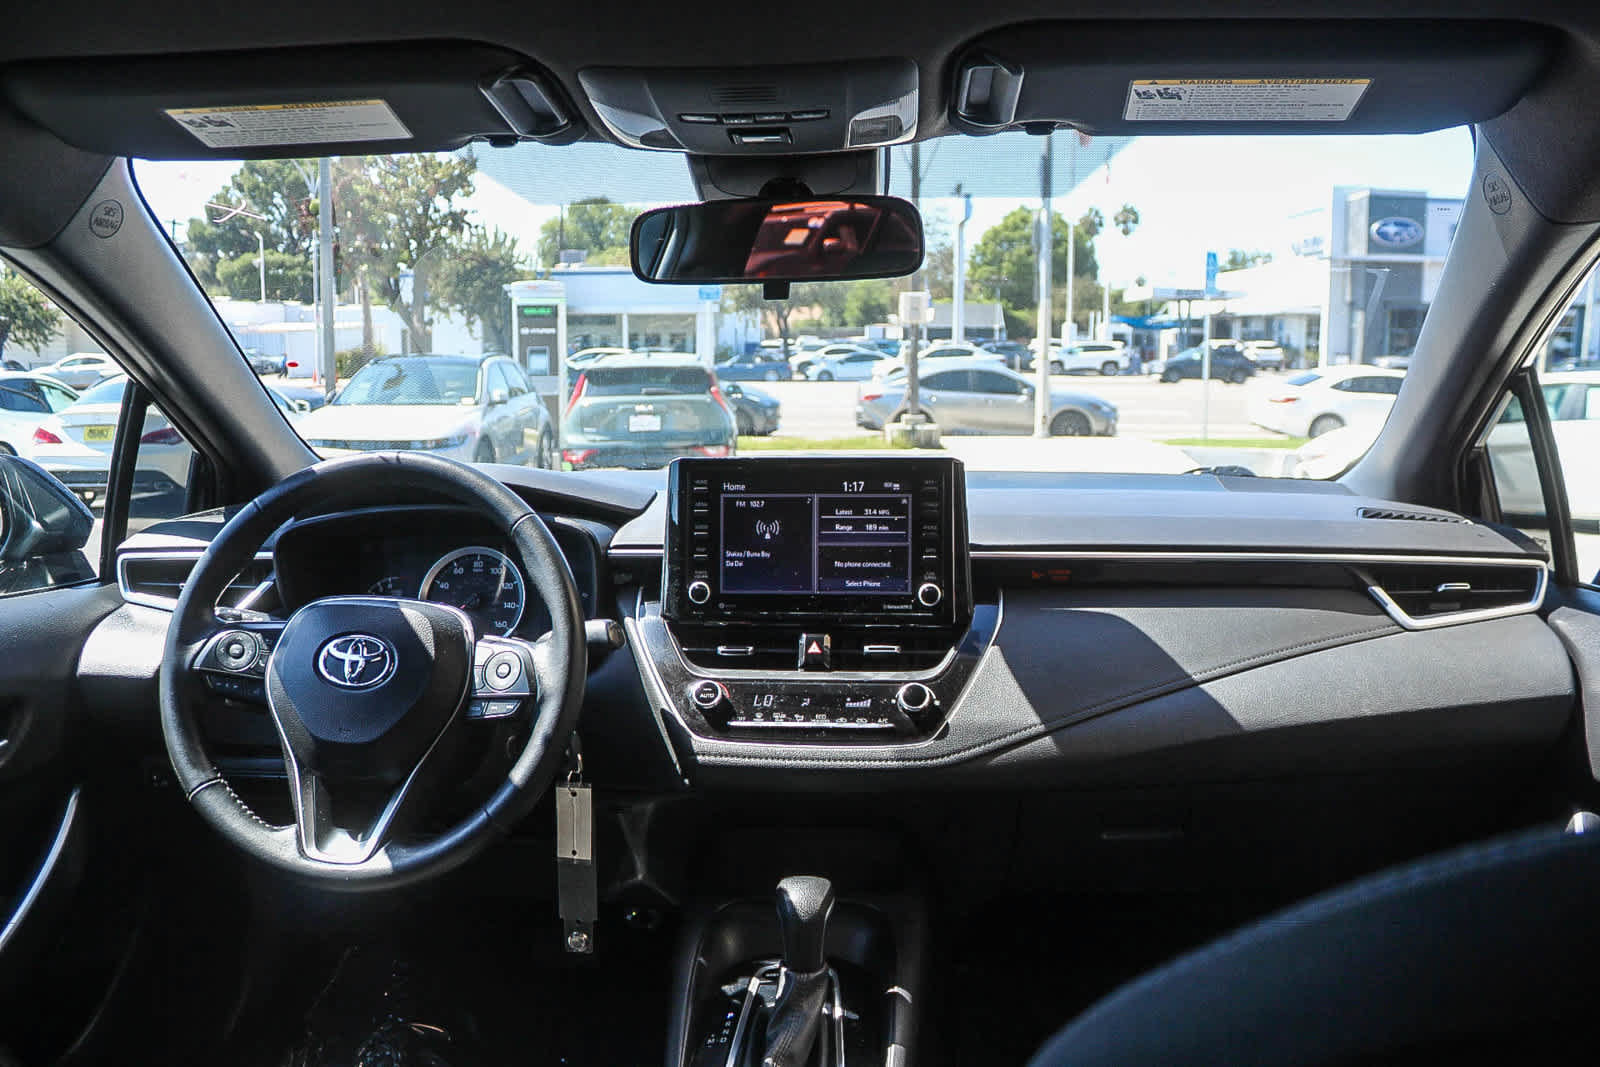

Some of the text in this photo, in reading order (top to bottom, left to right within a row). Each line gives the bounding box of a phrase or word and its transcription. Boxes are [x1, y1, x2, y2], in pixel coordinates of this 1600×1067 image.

[723, 482, 746, 491] Home
[842, 481, 865, 492] 1:17
[736, 500, 746, 508] FM
[865, 523, 878, 532] 189
[495, 620, 508, 628] 160
